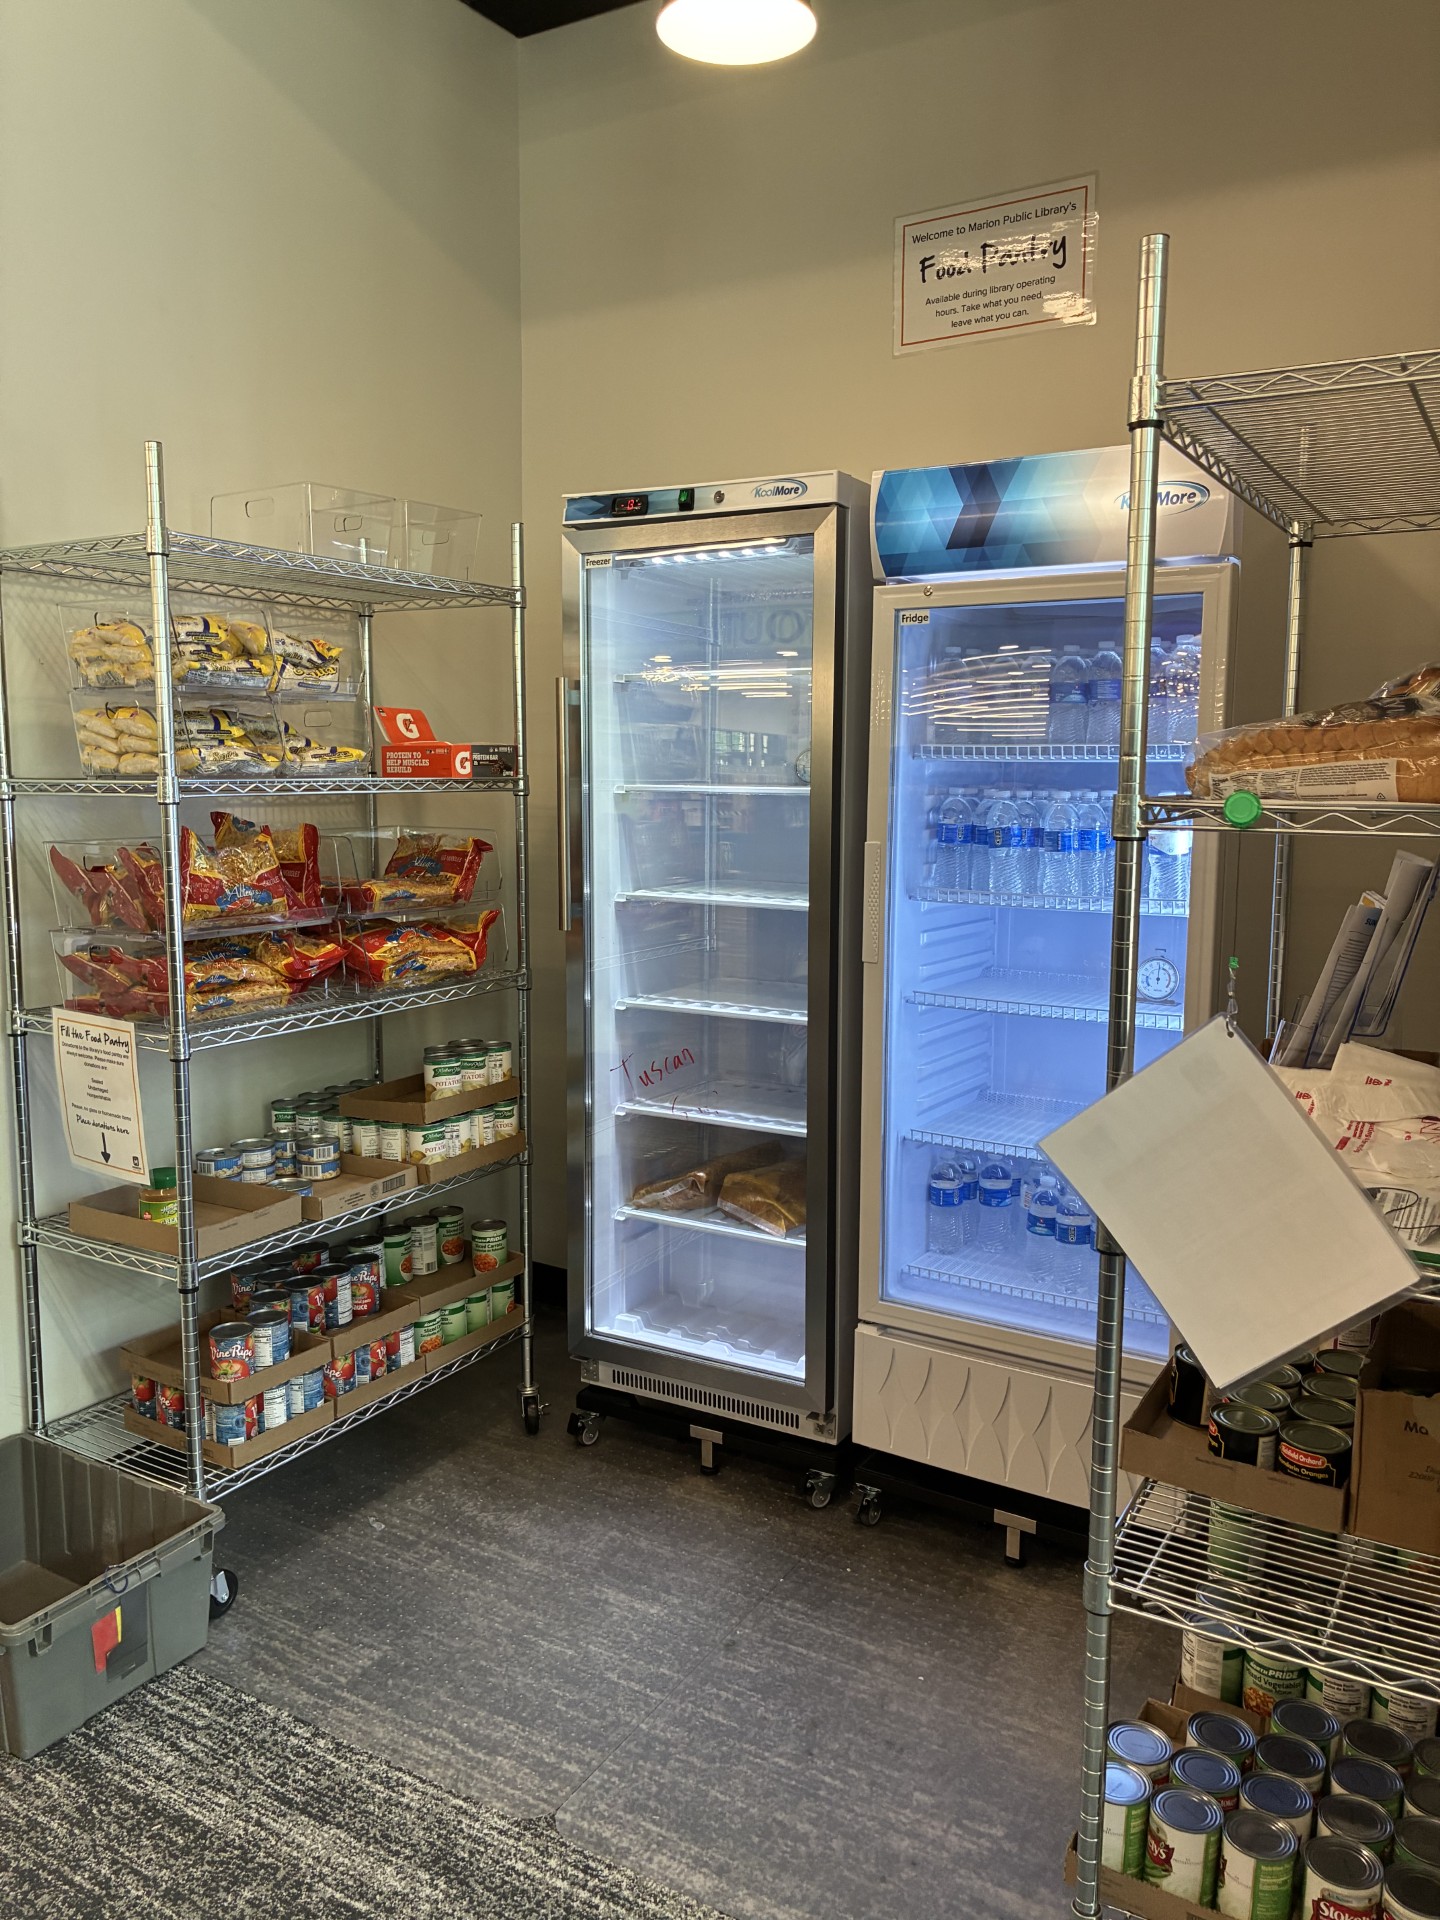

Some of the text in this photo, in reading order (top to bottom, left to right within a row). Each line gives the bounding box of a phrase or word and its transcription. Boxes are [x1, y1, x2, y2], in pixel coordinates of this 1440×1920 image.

[912, 202, 1077, 244] Welcome to Marion Public Library's
[919, 234, 1067, 283] Food Pantry
[925, 275, 1056, 305] Available during library operating
[935, 306, 959, 318] hours.
[961, 304, 981, 314] Take
[983, 299, 1002, 310] what
[1003, 296, 1019, 307] you
[951, 309, 1029, 328] leave what you can.
[754, 485, 800, 498] KoolMore
[585, 556, 611, 567] Freezer
[901, 612, 929, 624] Fridge
[396, 713, 420, 739] G
[386, 751, 422, 759] PROTEIN TO
[402, 759, 430, 767] MUSCLES
[455, 751, 471, 775] G
[386, 766, 412, 774] REBUILD
[60, 1025, 130, 1054] Fill the Food Pantry
[609, 1048, 695, 1098] Tuscan
[92, 1119, 116, 1131] donations
[117, 1125, 130, 1135] here
[210, 1346, 231, 1360] Vine
[231, 1344, 253, 1360] Ripe
[1299, 1454, 1324, 1466] Orchard
[1300, 1468, 1329, 1480] Oranges
[1268, 1669, 1299, 1680] PRIDE
